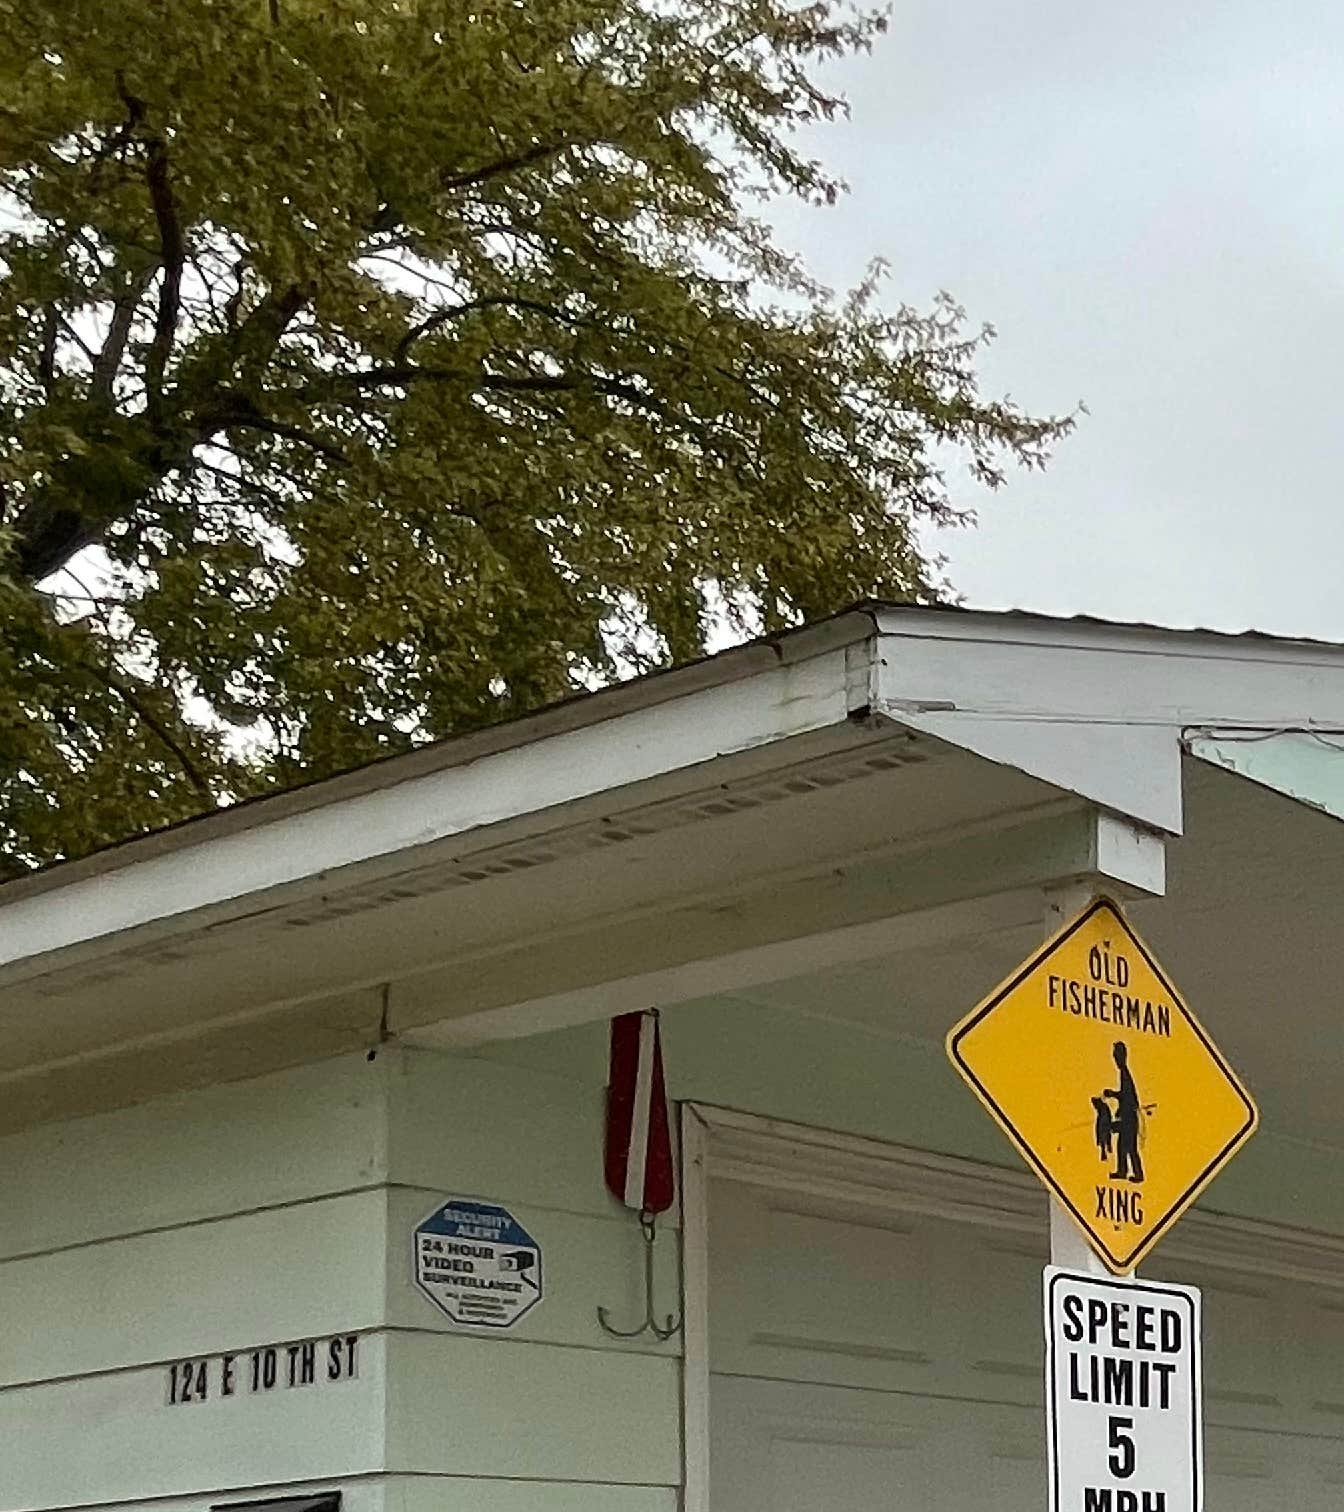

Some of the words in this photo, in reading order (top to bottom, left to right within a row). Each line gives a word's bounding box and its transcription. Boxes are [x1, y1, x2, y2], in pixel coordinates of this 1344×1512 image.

[1089, 945, 1128, 988] OLD
[1048, 975, 1171, 1038] FISHERMAN
[1095, 1186, 1143, 1226] XING
[422, 1238, 444, 1253] 24
[447, 1242, 494, 1260] HOUR
[422, 1255, 474, 1273] VIDEO
[1062, 1294, 1182, 1354] SPEED
[168, 1361, 207, 1405] 124
[221, 1354, 235, 1396] E
[328, 1335, 358, 1380] ST
[1070, 1352, 1176, 1410] LIMIT
[1108, 1415, 1136, 1479] 5
